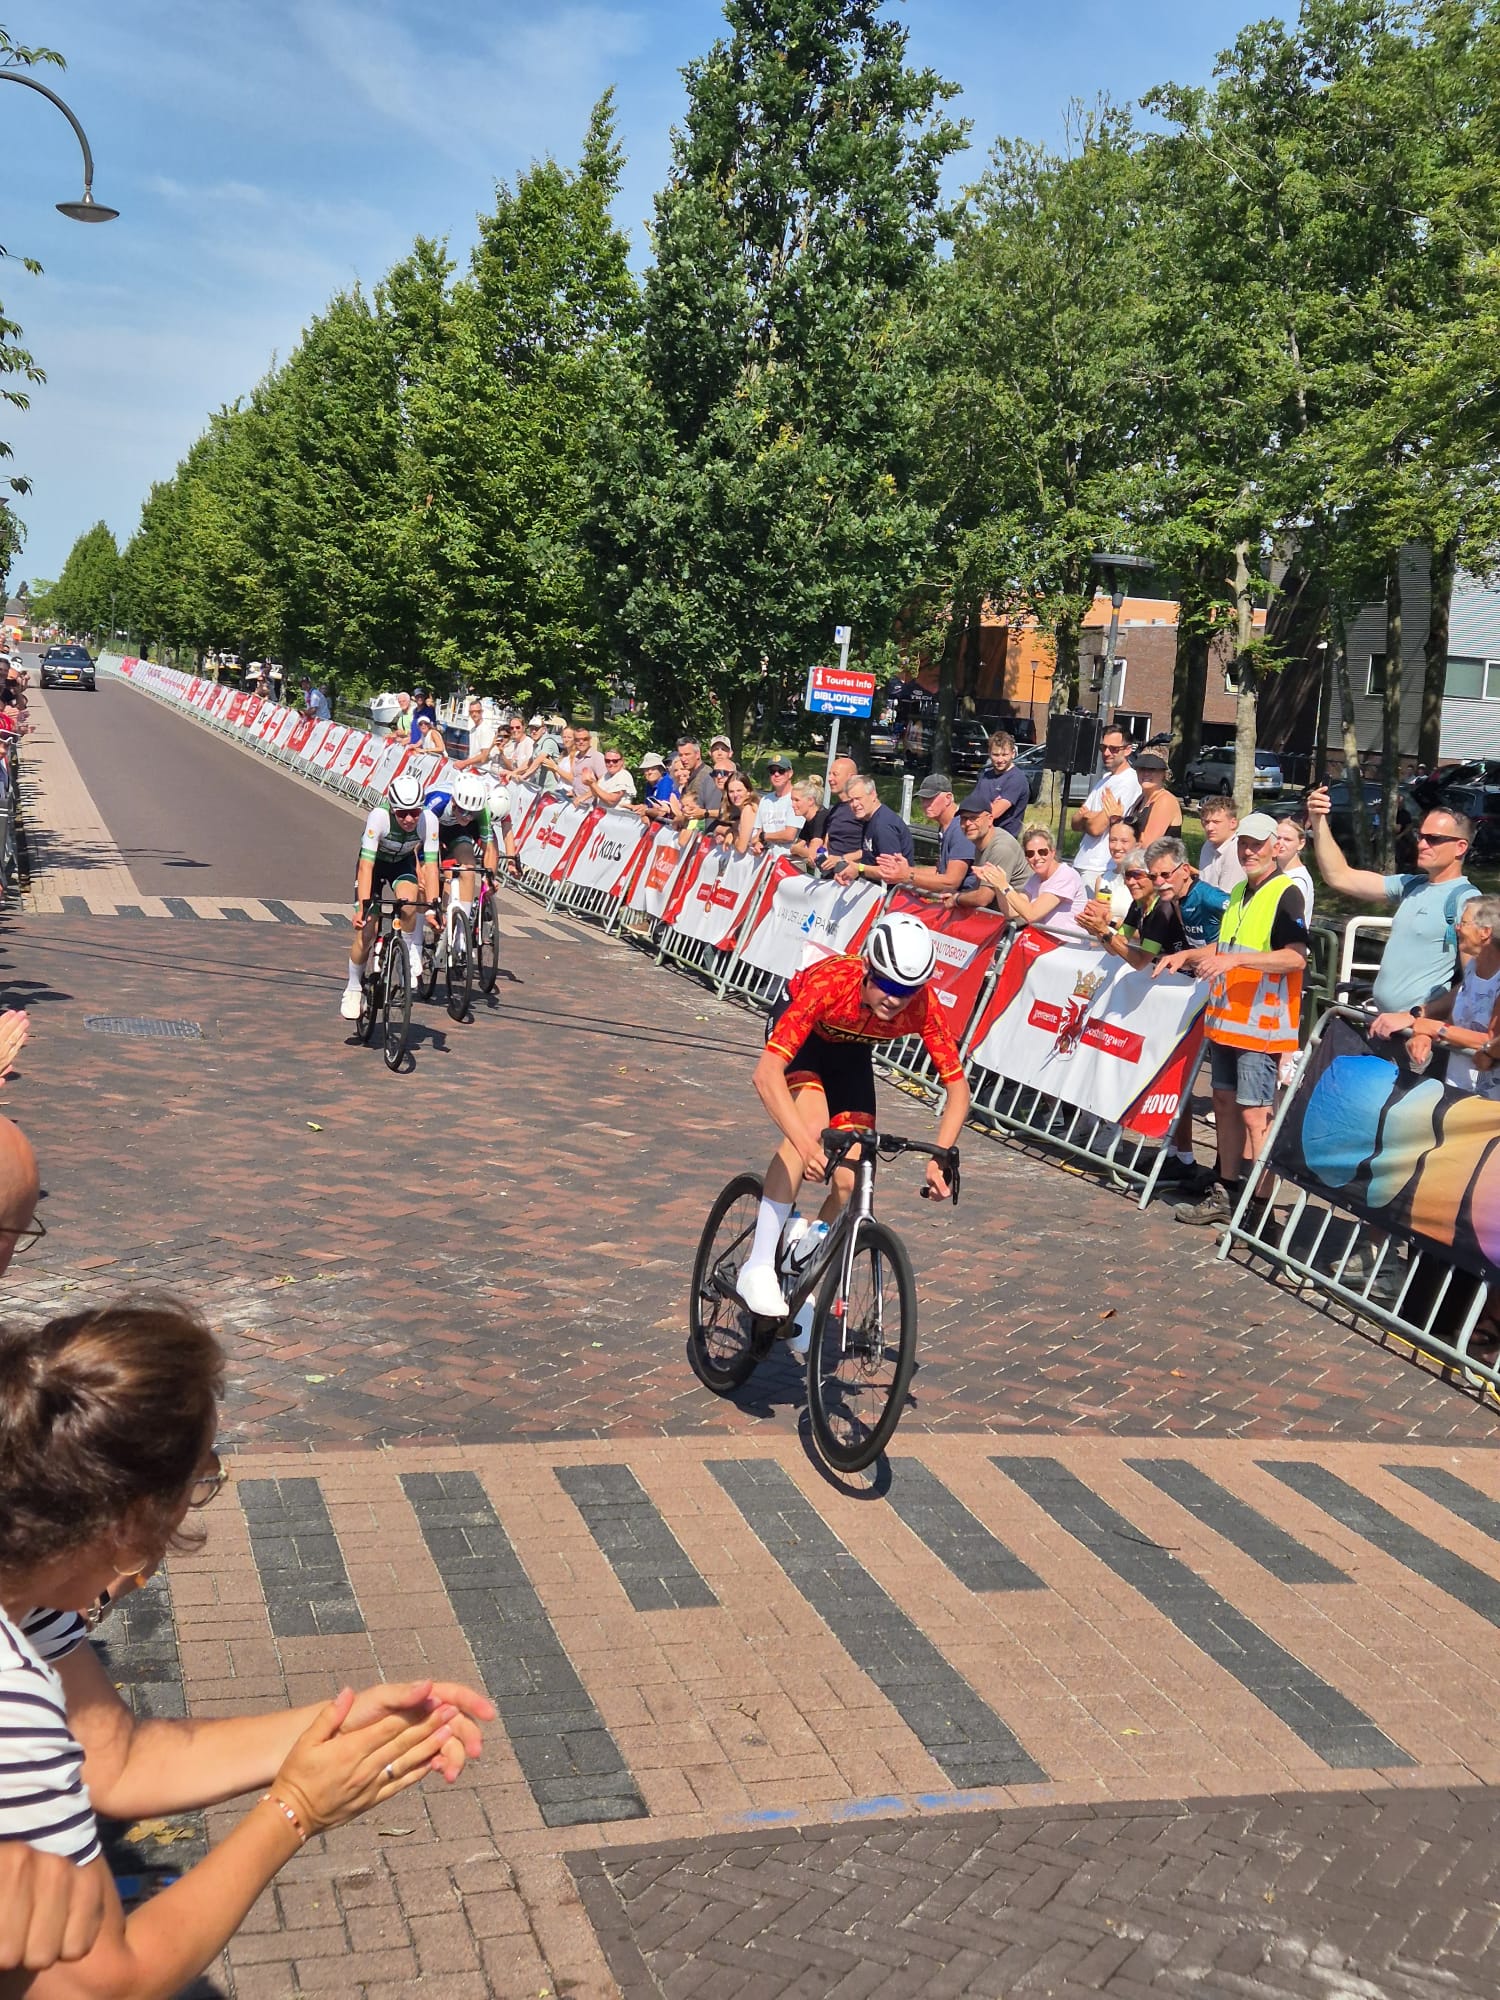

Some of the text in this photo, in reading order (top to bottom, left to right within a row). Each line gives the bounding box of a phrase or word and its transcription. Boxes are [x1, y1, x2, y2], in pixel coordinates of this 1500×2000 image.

[825, 674, 854, 687] Tourist
[856, 678, 873, 689] Info
[813, 690, 870, 706] BIBLIOTHEEK
[1140, 1093, 1179, 1115] #OVO
